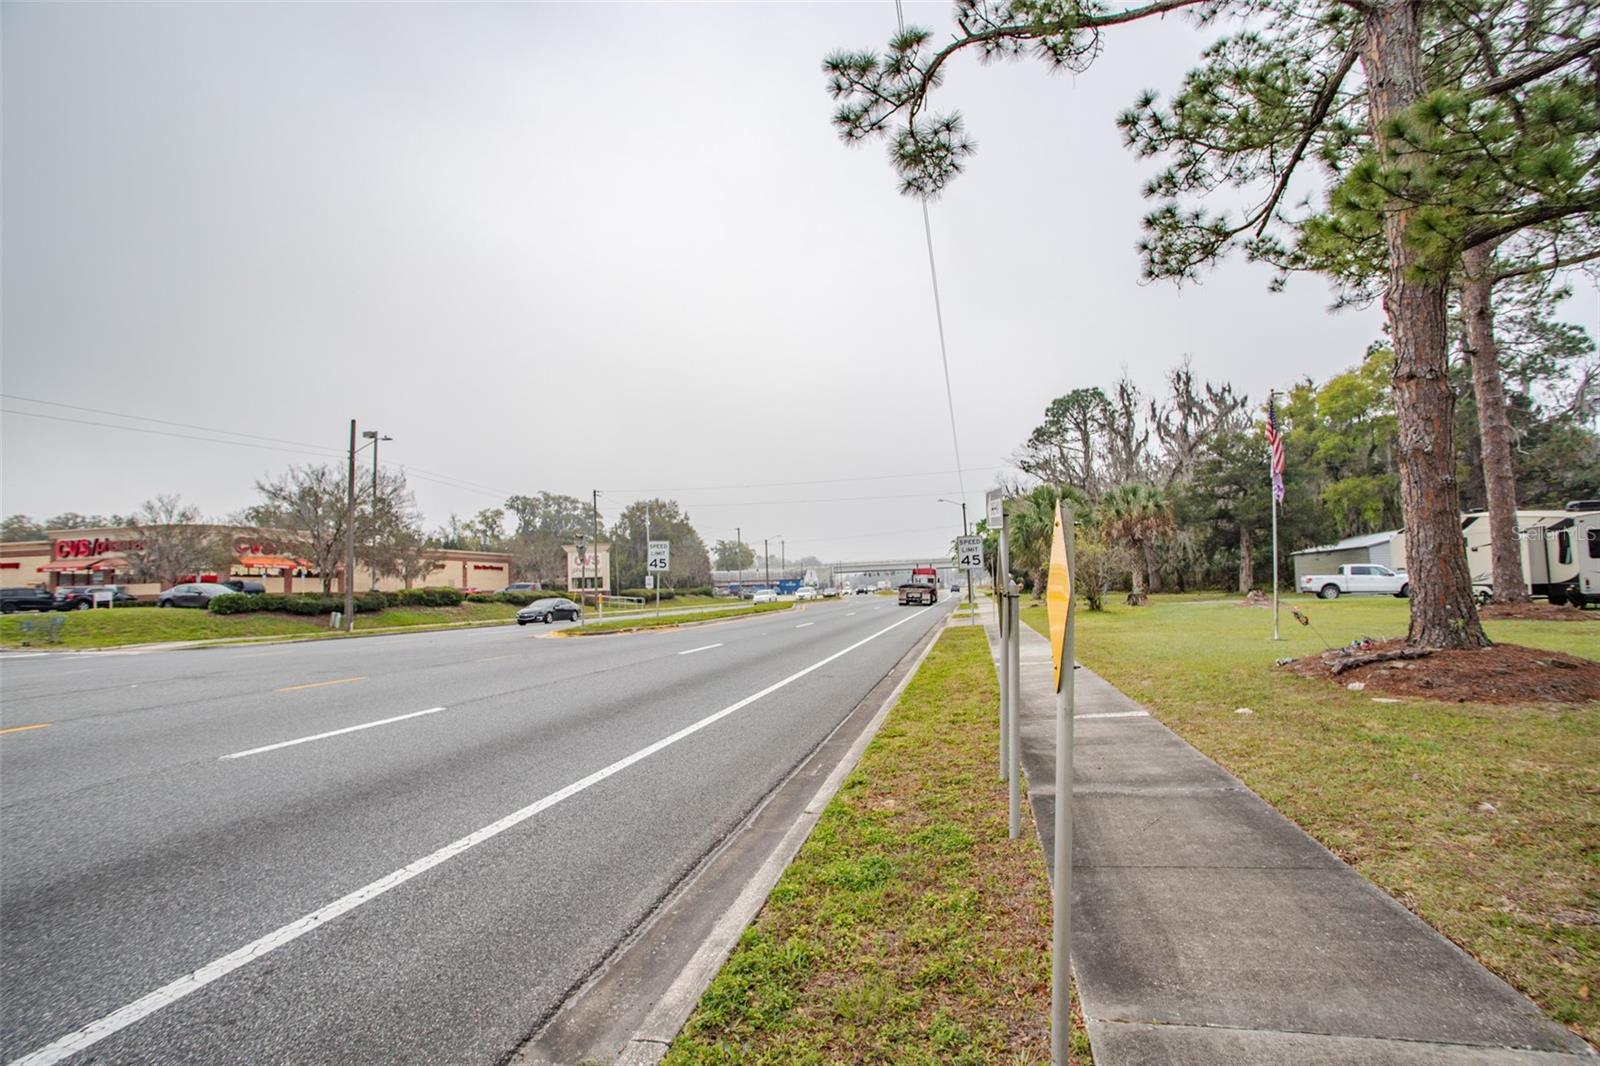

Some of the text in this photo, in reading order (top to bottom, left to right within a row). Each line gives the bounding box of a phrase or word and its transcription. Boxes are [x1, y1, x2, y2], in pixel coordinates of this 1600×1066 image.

[574, 551, 600, 566] CVS
[649, 558, 667, 569] 45
[961, 554, 981, 566] 45
